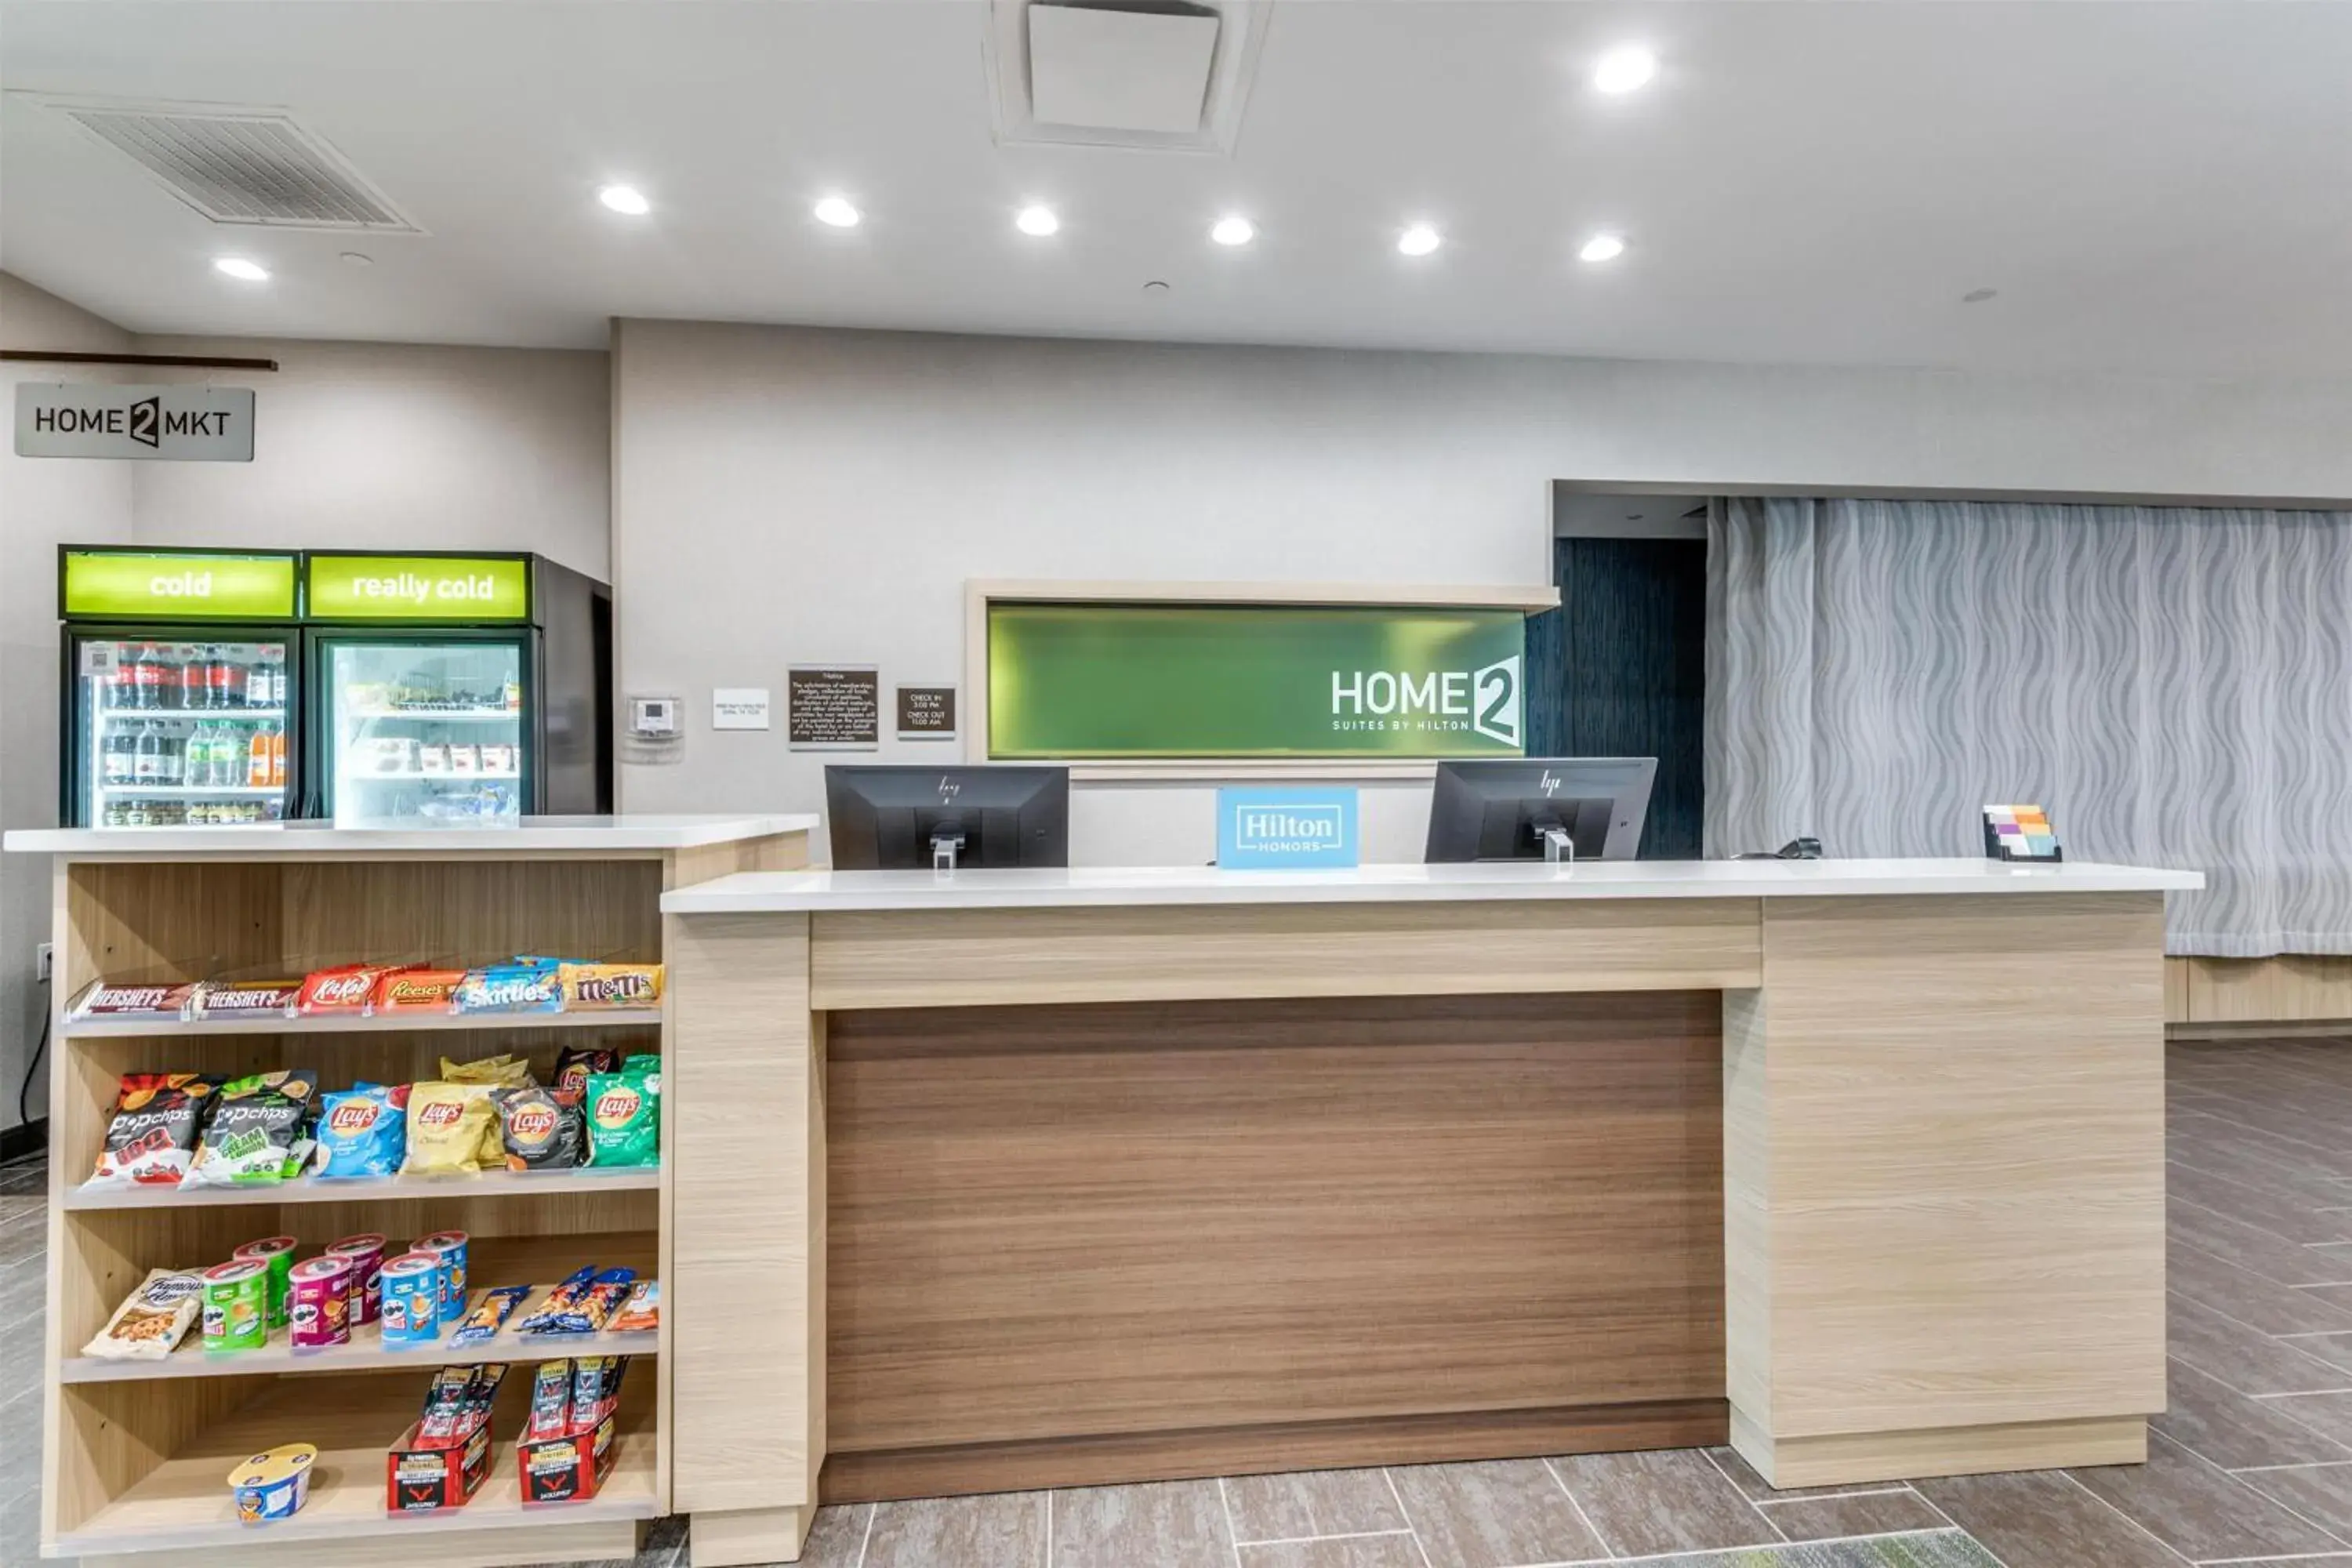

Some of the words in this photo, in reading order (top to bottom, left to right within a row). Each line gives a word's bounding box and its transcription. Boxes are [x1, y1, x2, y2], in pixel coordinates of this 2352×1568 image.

[36, 407, 124, 434] HOME
[165, 411, 231, 436] MKT
[151, 572, 212, 597] cold
[353, 574, 430, 603] really
[437, 574, 494, 600] cold
[1332, 671, 1468, 714] HOME
[907, 710, 929, 719] CHECK
[931, 710, 945, 719] OUT
[1332, 720, 1385, 731] SUITES
[1392, 720, 1410, 731] BY
[1417, 720, 1469, 731] HILTON
[1247, 814, 1333, 838] Hilton
[1258, 841, 1321, 852] HONORS
[467, 981, 550, 1008] Skittles
[108, 1109, 193, 1134] popchips
